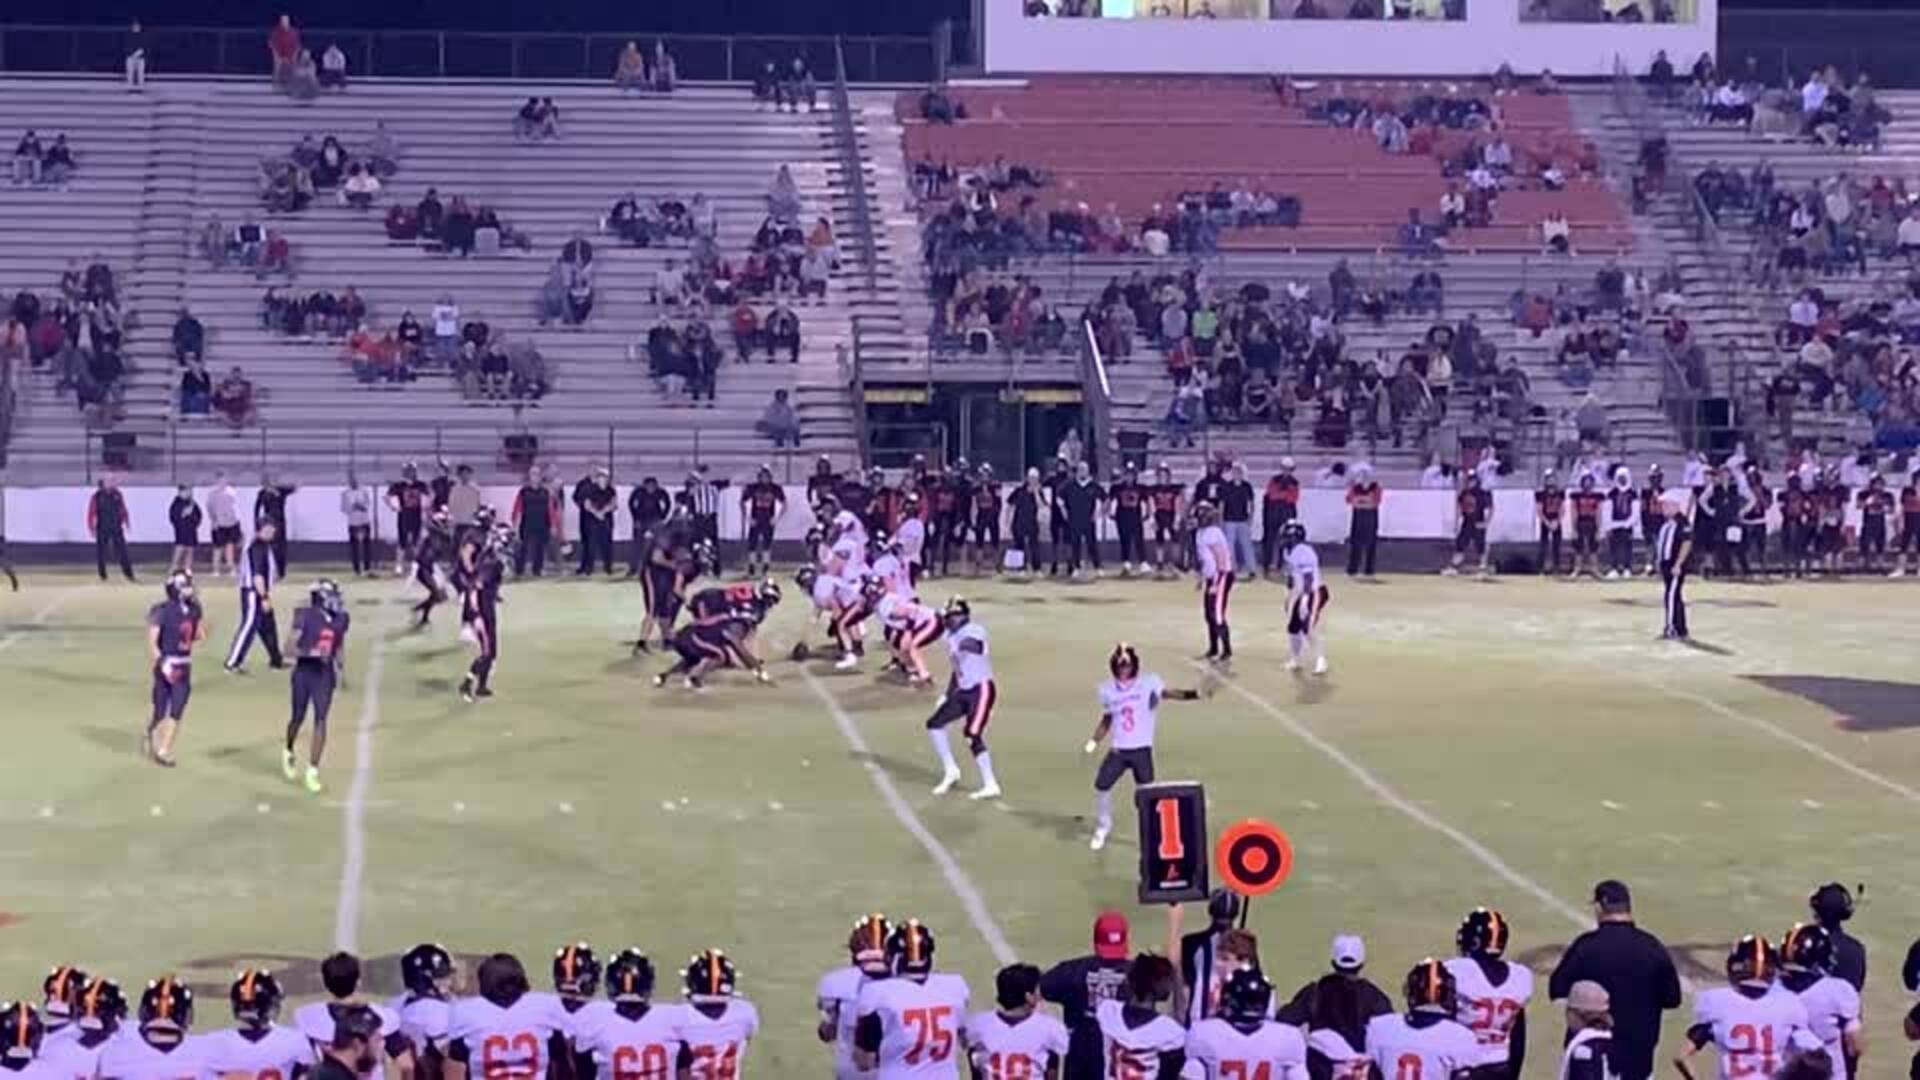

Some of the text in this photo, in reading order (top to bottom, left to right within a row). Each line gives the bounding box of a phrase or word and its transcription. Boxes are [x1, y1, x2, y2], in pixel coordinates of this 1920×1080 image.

[1120, 705, 1136, 732] 3
[1155, 798, 1184, 860] 1
[903, 1006, 953, 1066] 75
[1729, 1023, 1774, 1077] 21
